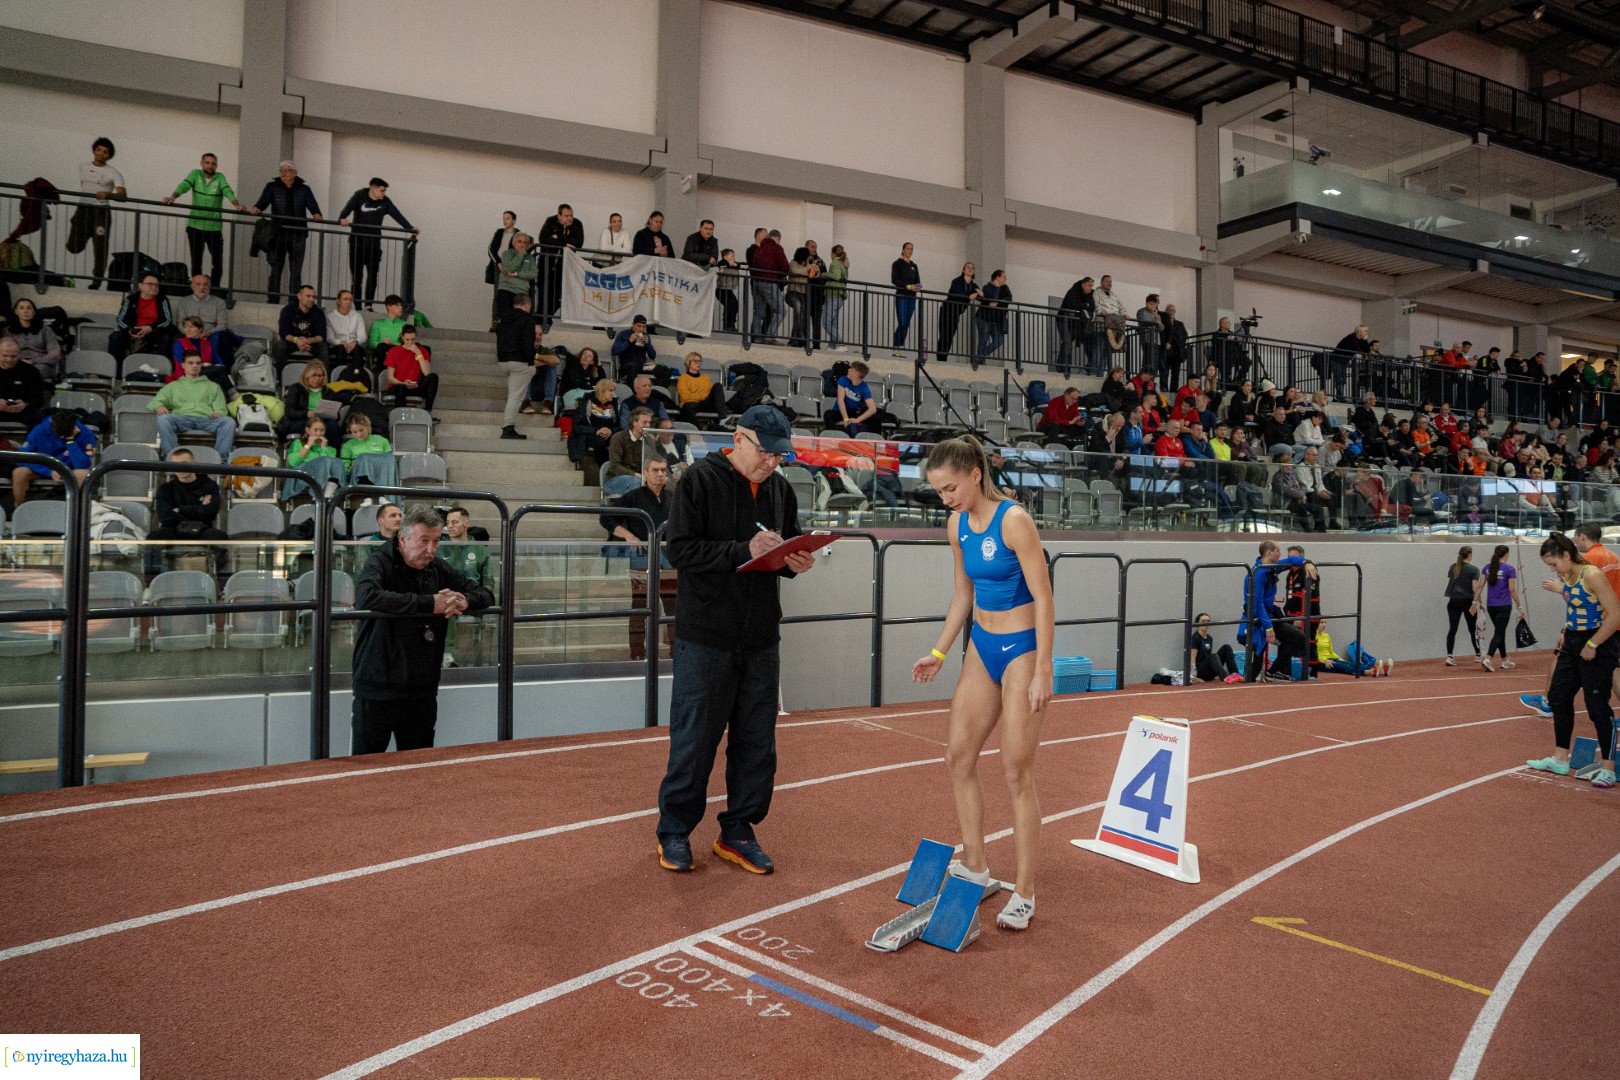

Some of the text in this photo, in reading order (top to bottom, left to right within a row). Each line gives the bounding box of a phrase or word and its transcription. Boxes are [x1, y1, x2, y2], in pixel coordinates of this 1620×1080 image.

[1149, 731, 1179, 744] polanik
[1119, 748, 1173, 834] 4
[736, 927, 814, 961] 200
[615, 971, 698, 1008] 400
